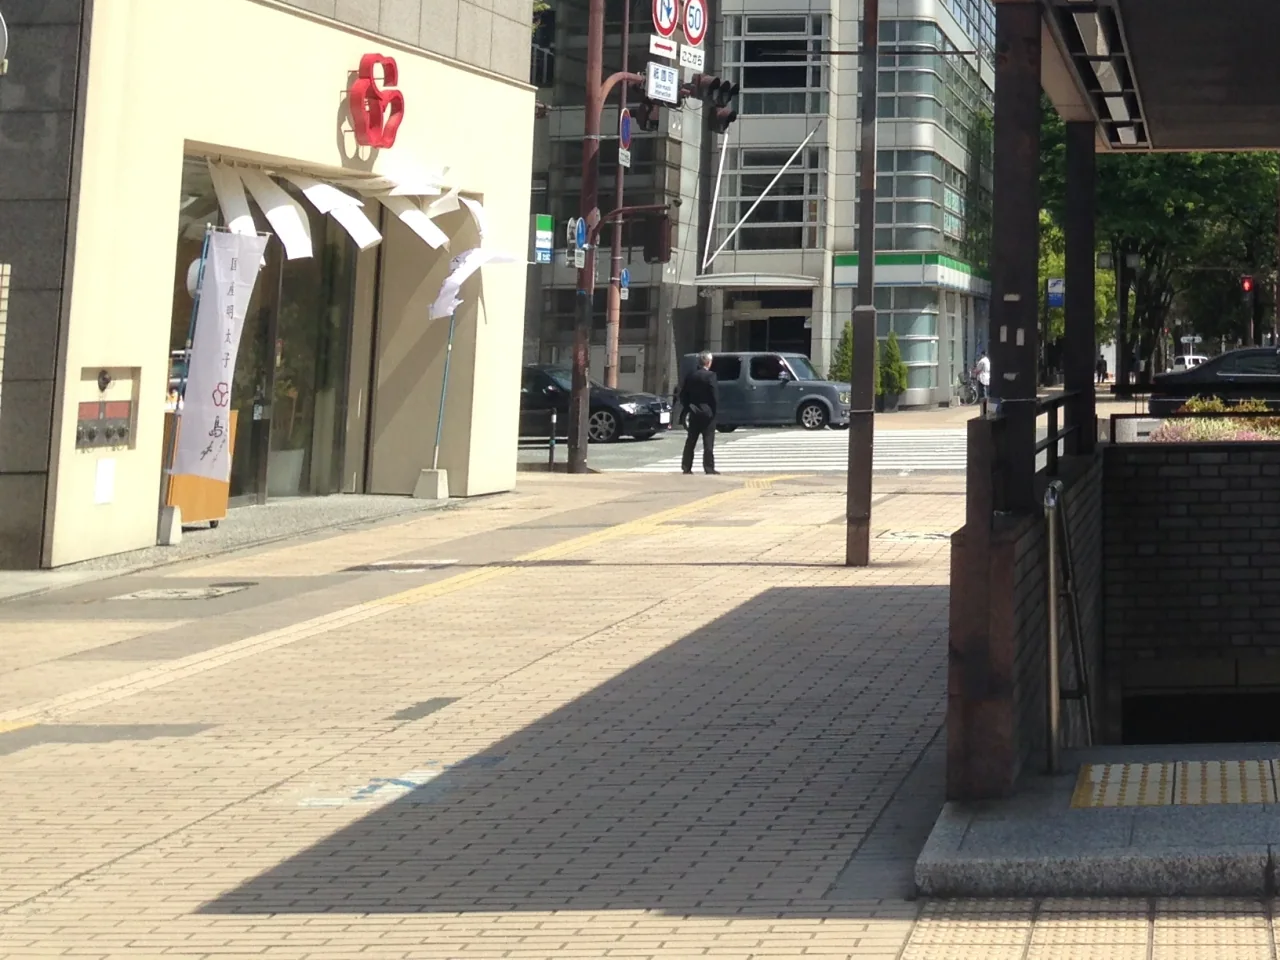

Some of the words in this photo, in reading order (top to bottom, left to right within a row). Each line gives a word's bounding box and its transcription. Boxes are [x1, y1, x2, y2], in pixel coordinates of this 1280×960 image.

[688, 5, 701, 29] 50
[682, 50, 702, 66] ここから
